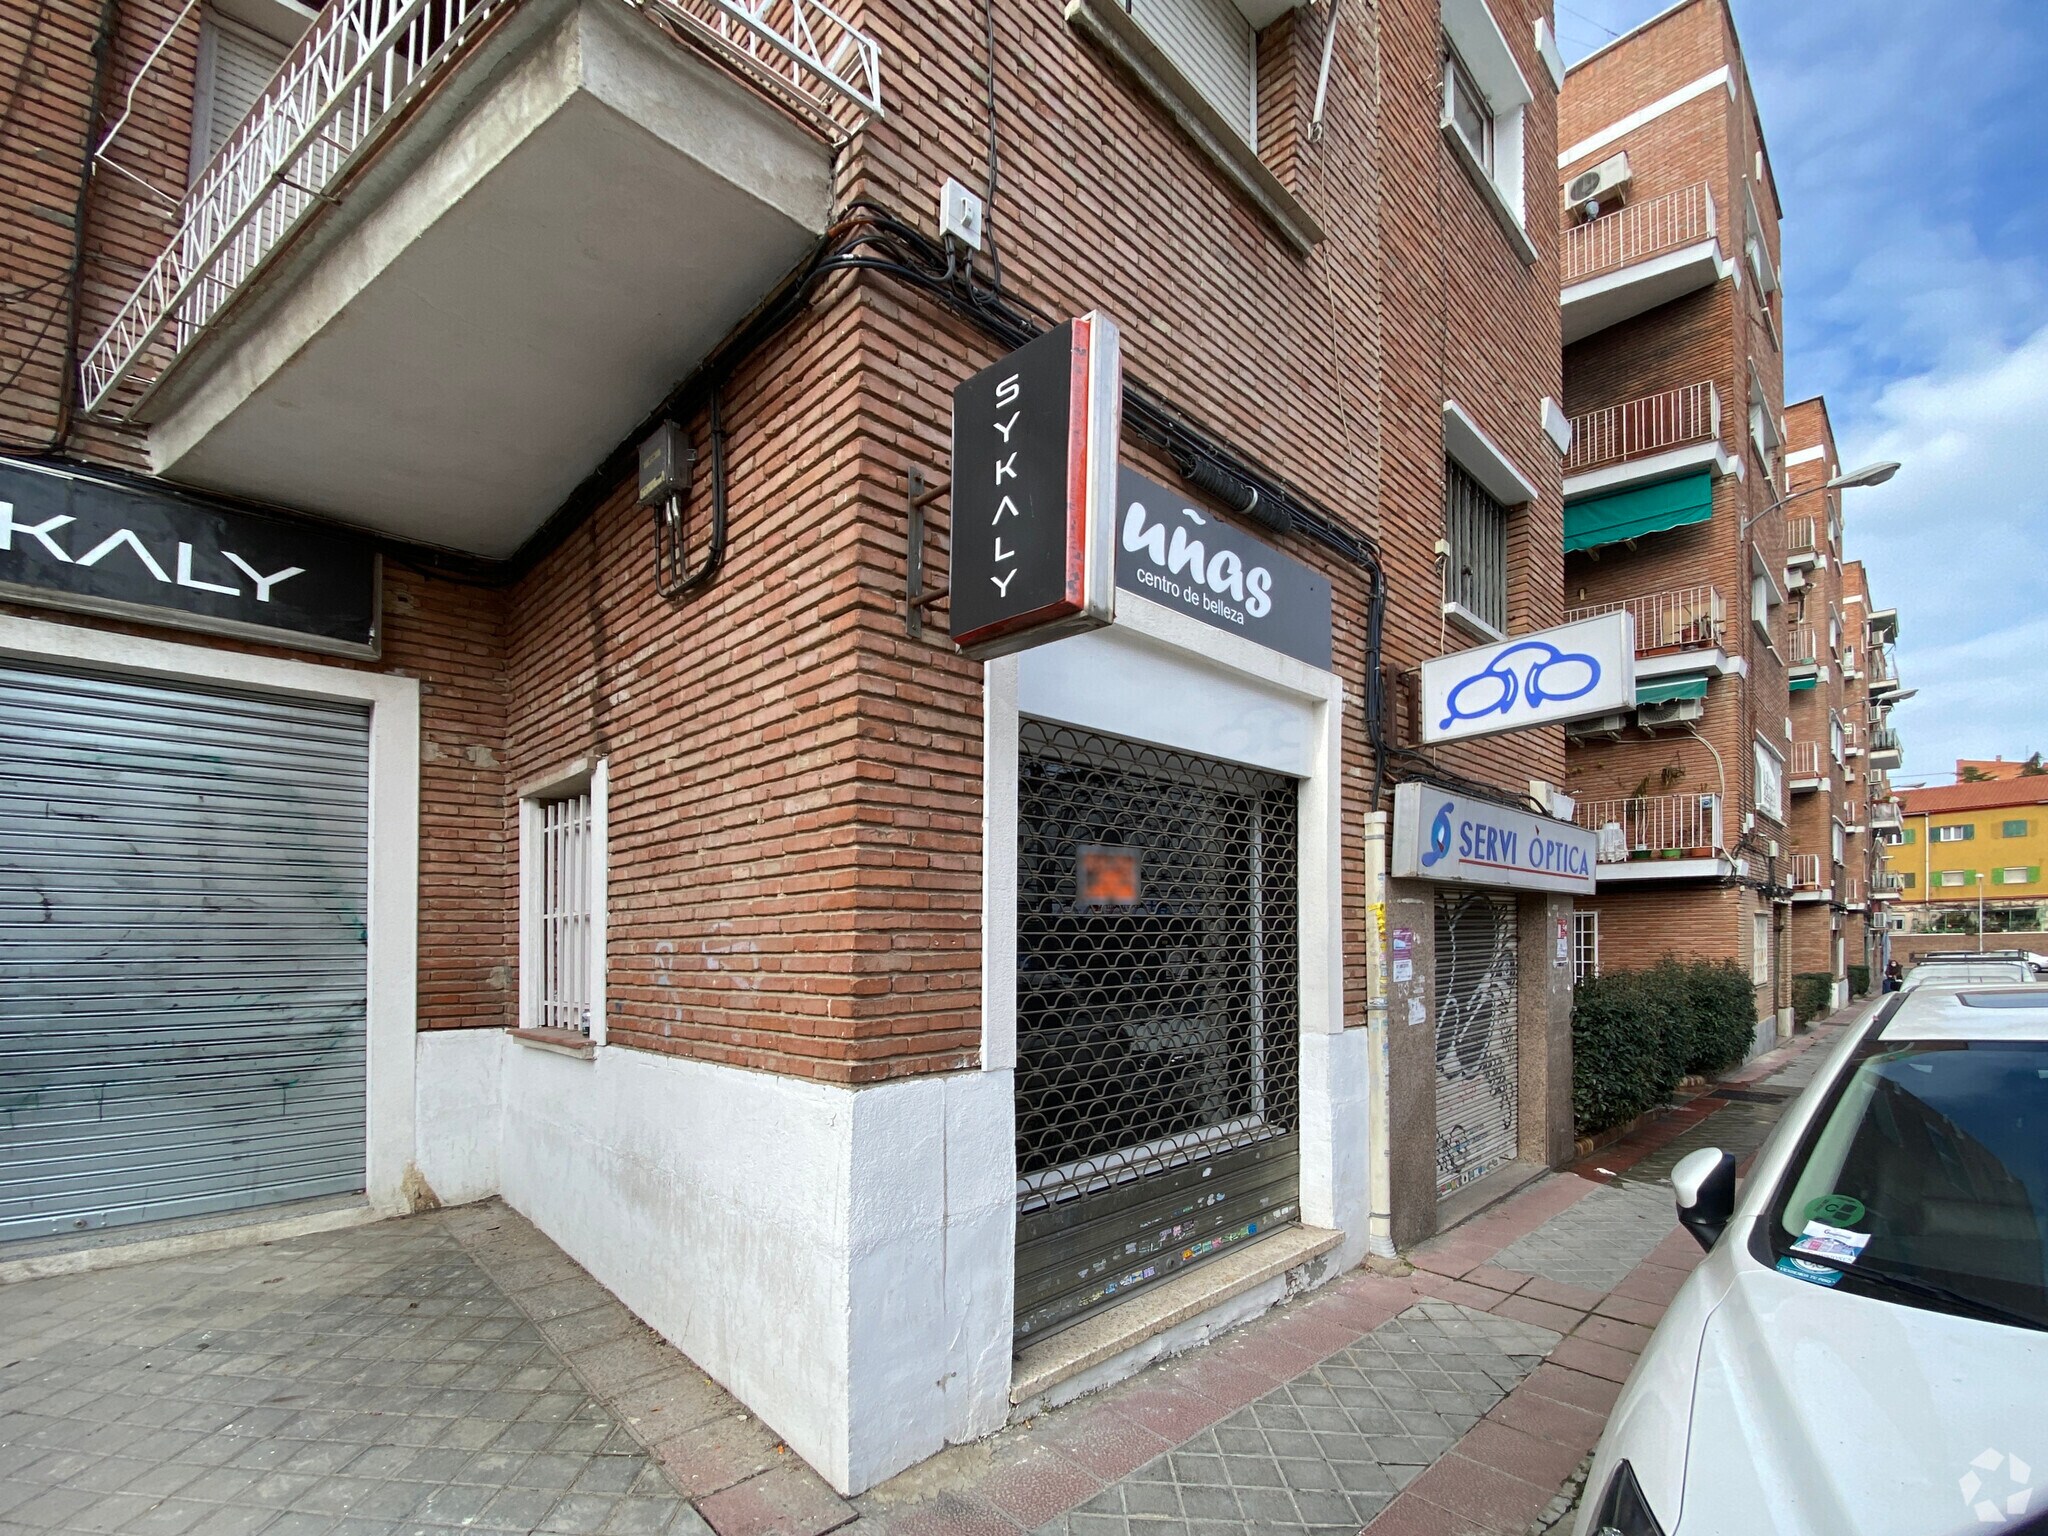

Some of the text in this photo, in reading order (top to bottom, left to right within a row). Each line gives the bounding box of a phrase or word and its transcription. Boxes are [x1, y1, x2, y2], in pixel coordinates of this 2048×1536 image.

[990, 373, 1020, 598] SYKALY
[1122, 502, 1272, 618] uñas
[1136, 567, 1245, 625] centro de belleza
[1459, 820, 1517, 865] SERVI
